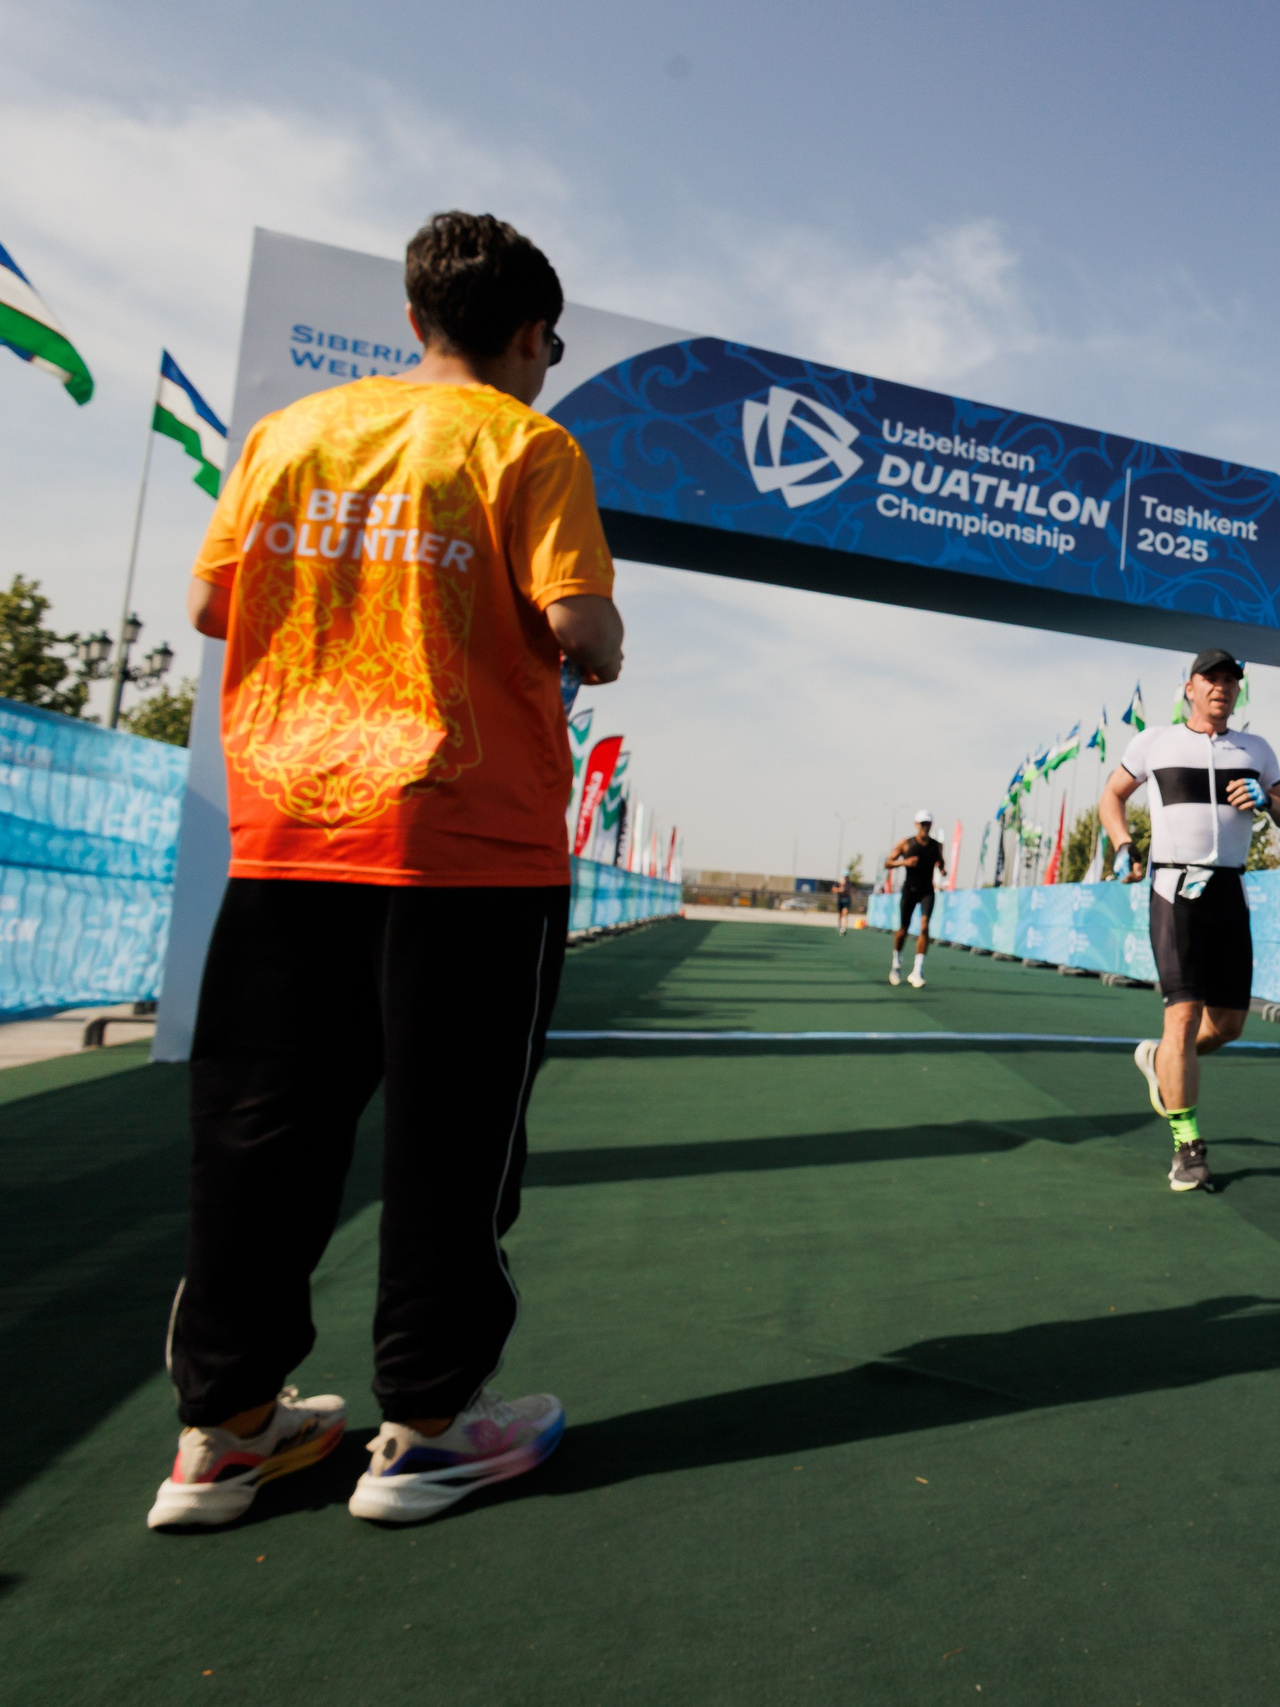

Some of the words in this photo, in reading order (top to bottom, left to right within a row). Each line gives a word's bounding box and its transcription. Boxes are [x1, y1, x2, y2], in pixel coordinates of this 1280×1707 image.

[290, 323, 423, 367] SIBERIA
[881, 418, 1036, 473] Uzbekistan
[306, 488, 411, 527] BEST
[876, 454, 1111, 529] DUATHLON
[876, 493, 1076, 555] Championship
[1140, 494, 1259, 542] Tashkent
[1136, 528, 1209, 563] 2025
